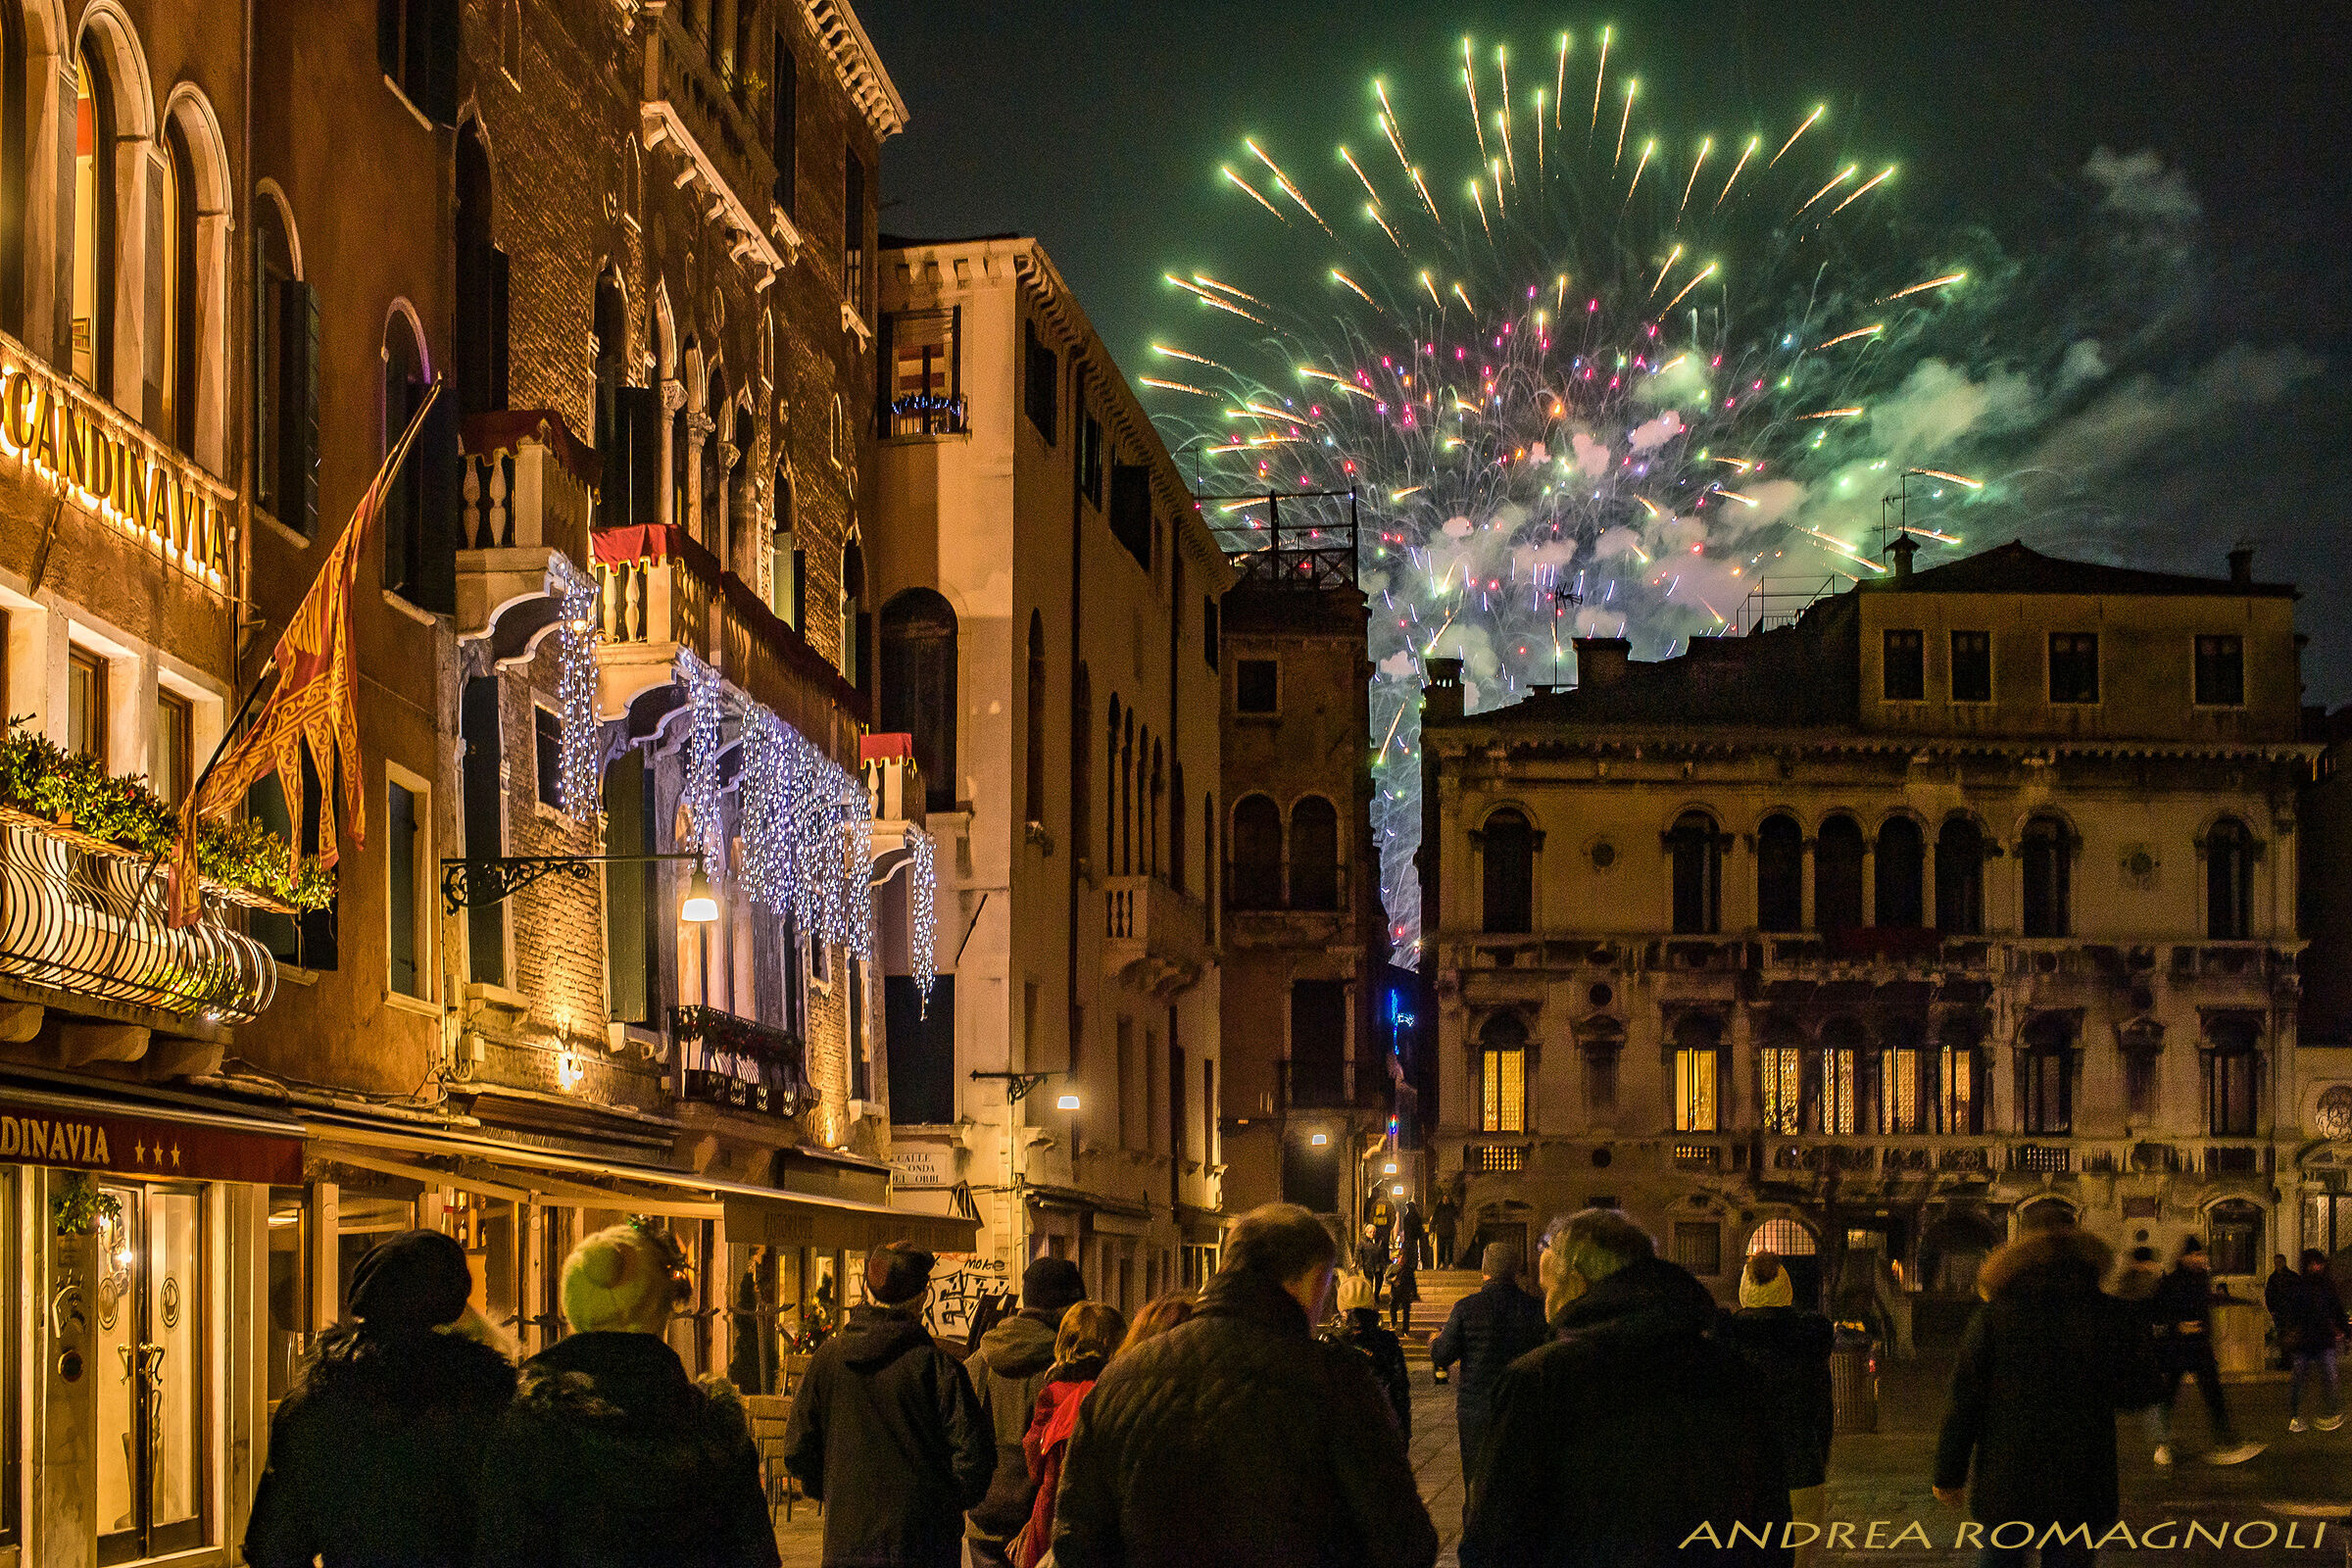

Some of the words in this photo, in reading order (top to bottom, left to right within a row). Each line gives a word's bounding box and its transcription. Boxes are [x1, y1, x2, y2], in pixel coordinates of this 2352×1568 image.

[0, 368, 230, 576] CANDINAVIA
[0, 1115, 111, 1165] DINAVIA
[897, 1153, 931, 1163] CALLE
[906, 1164, 935, 1173] ONDA
